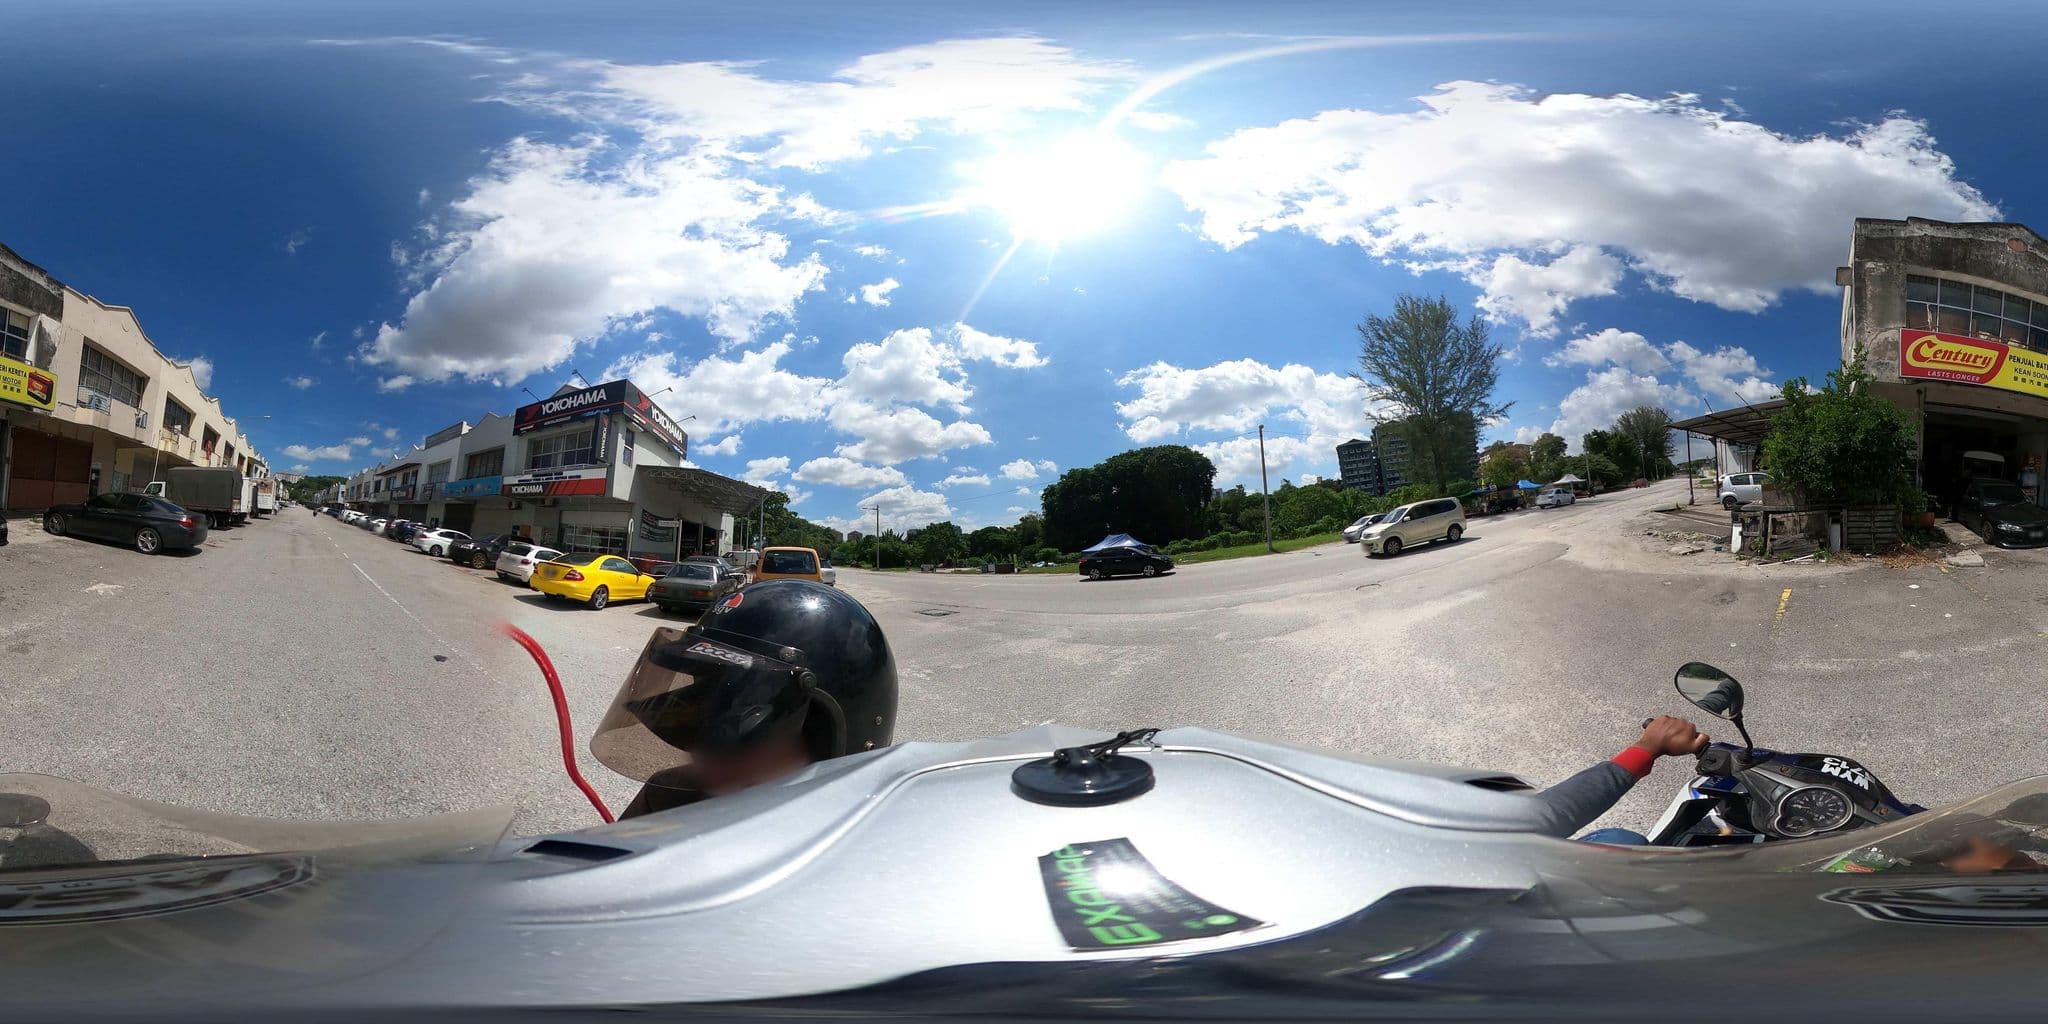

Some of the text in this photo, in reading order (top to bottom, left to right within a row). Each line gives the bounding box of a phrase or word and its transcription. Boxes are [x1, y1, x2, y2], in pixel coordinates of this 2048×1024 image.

[1912, 340, 1993, 369] Century
[2008, 354, 2033, 367] PENJUAL
[1927, 370, 1981, 382] LASTS LONGER
[2014, 367, 2031, 376] KEAN
[541, 388, 607, 415] YOKOHAMA
[651, 405, 683, 443] YOKOHAMA
[512, 484, 544, 494] YOKOHAMA
[1821, 763, 1869, 790] WYM
